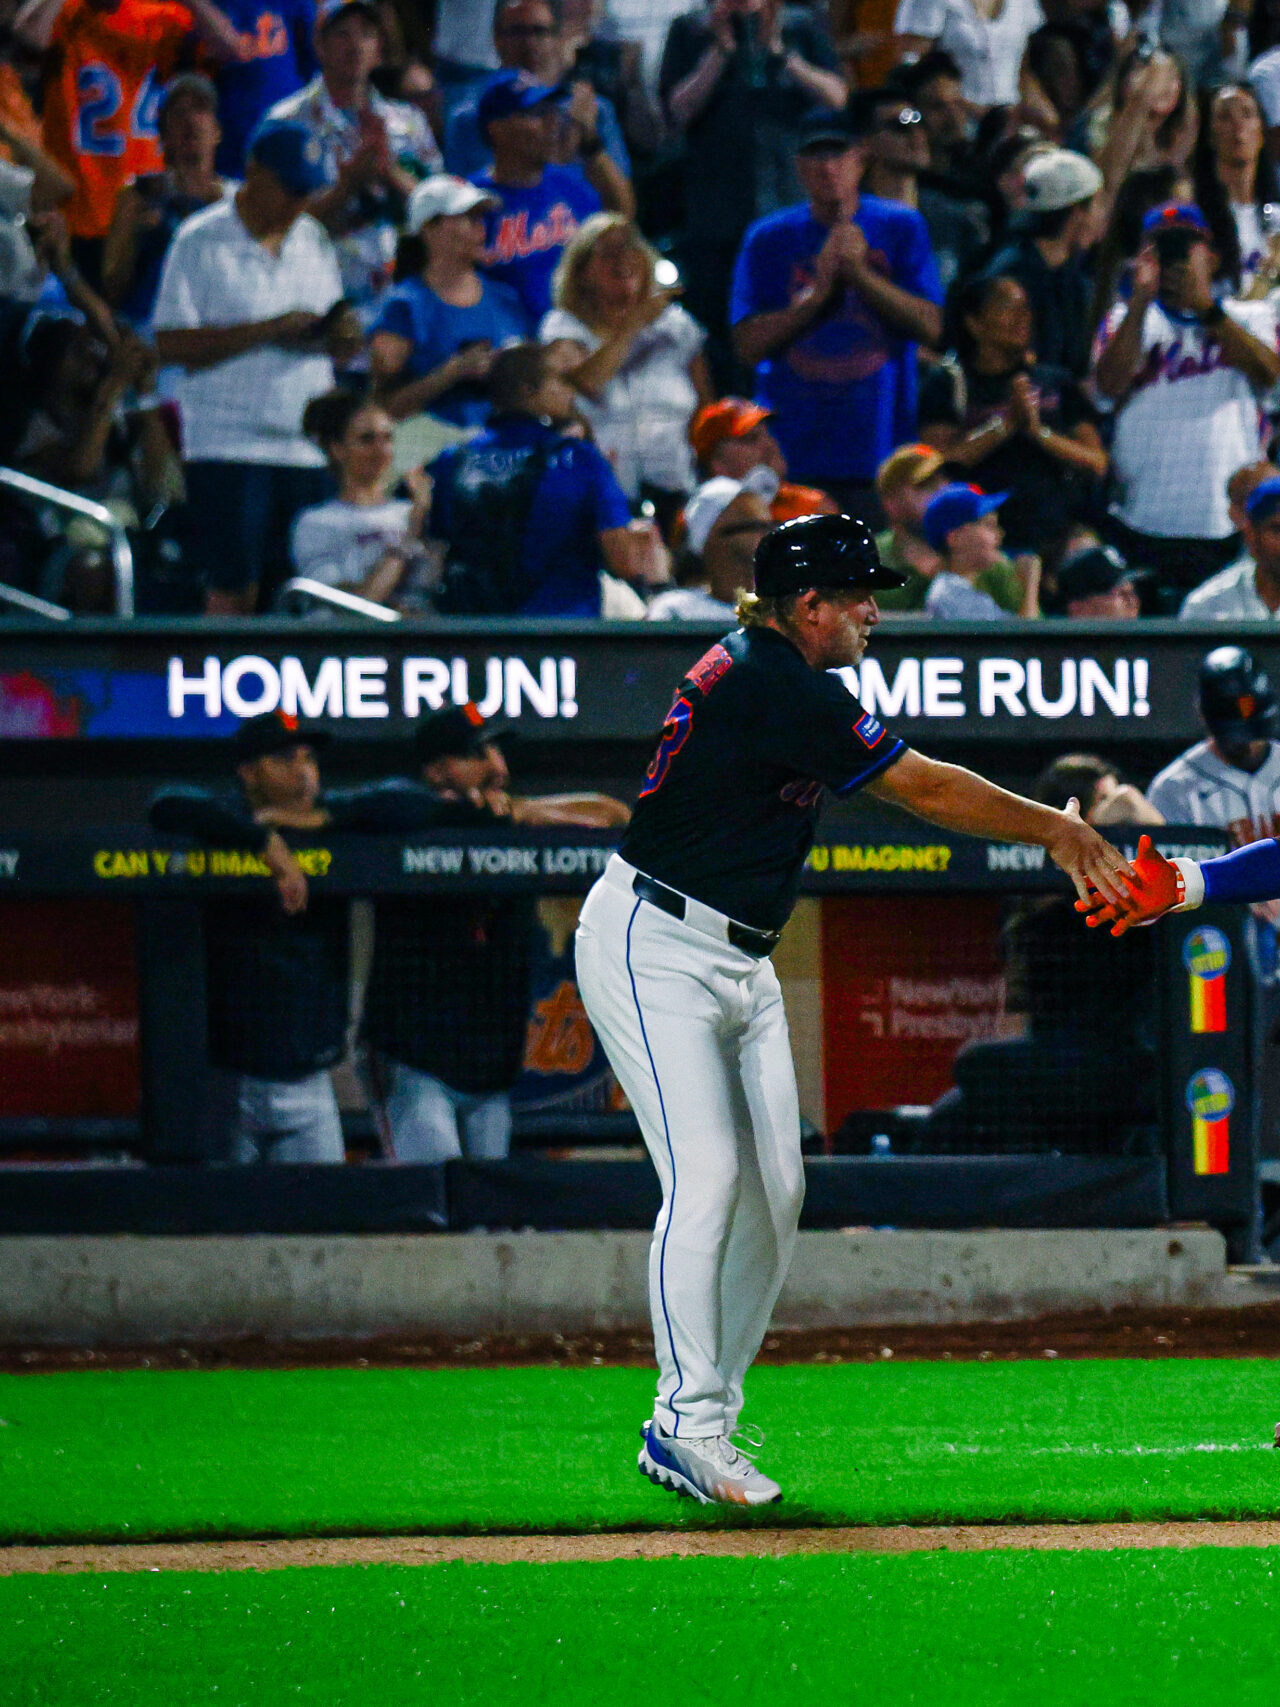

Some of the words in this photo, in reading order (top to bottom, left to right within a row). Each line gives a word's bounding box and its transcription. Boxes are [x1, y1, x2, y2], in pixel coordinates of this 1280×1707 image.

[167, 656, 389, 717] HOME
[402, 657, 579, 717] RUN!
[978, 657, 1150, 718] RUN!
[94, 849, 149, 878] CAN
[403, 847, 464, 874] NEW
[469, 846, 539, 874] YORK
[832, 845, 952, 871] IMAGINE?
